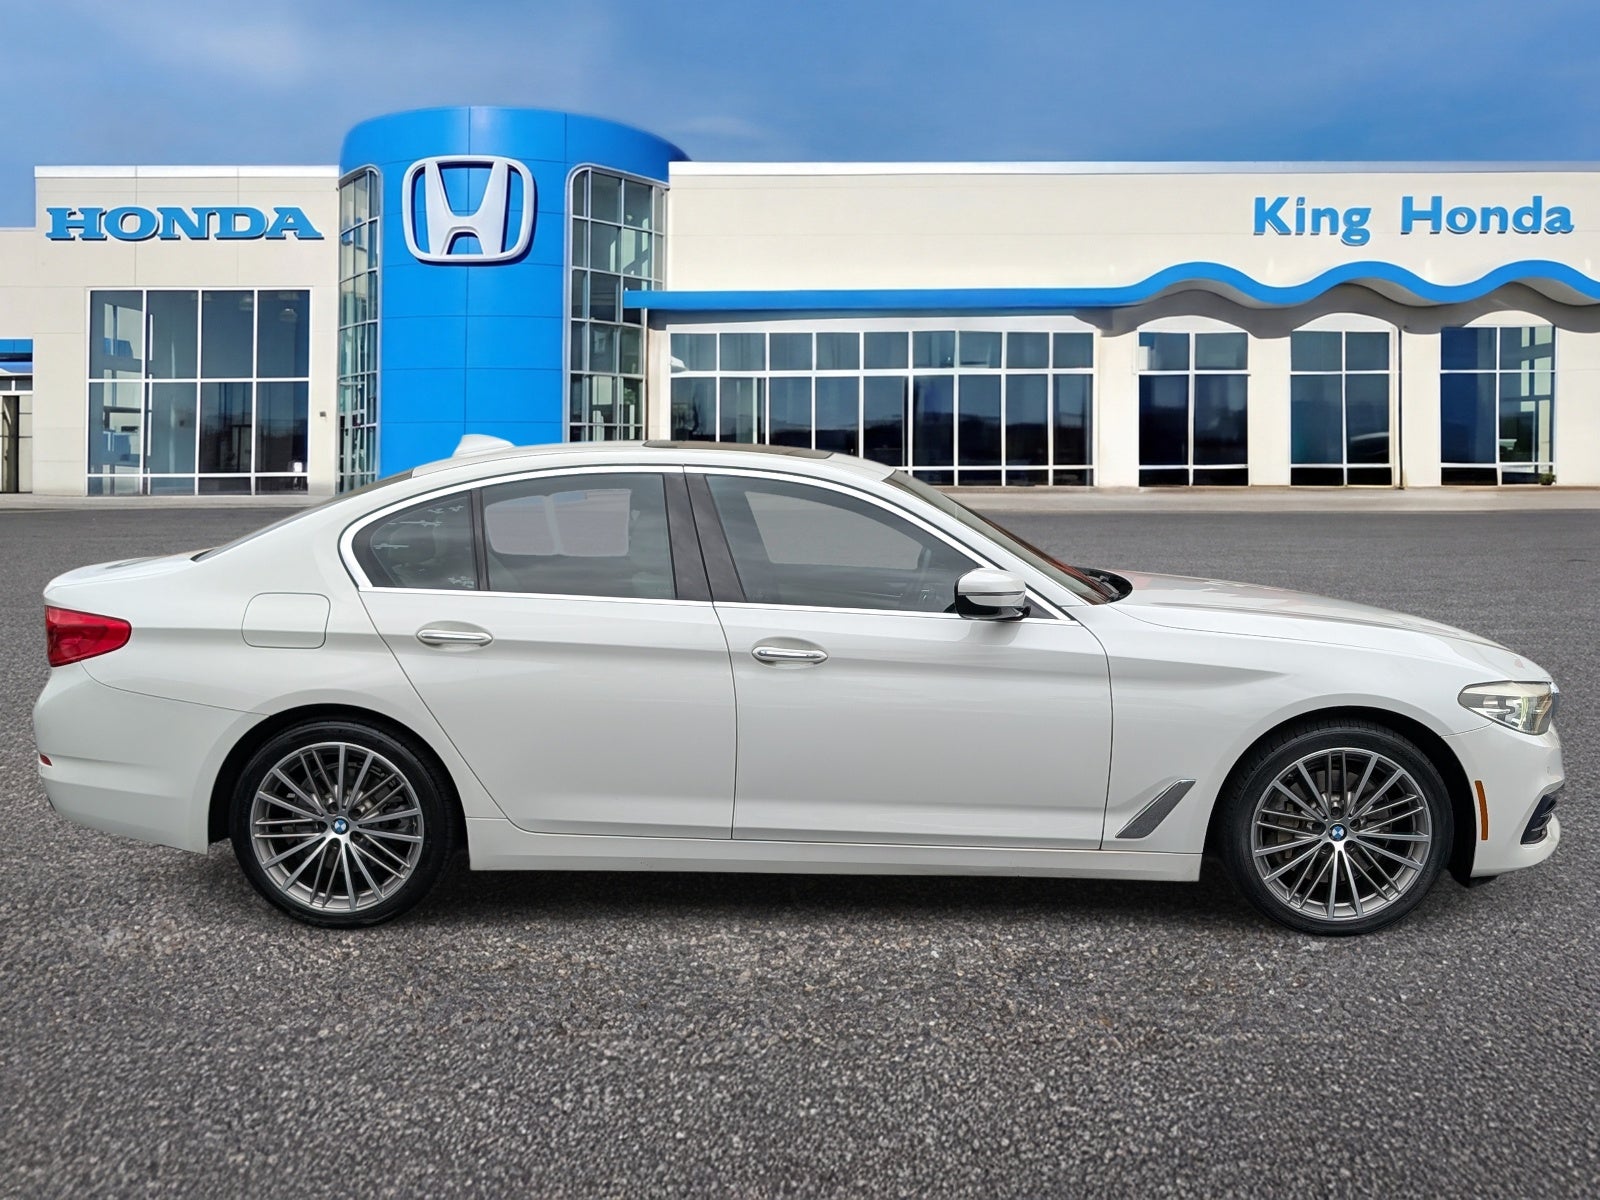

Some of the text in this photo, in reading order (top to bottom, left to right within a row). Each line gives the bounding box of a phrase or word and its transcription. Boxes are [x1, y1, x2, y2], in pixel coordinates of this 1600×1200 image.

[45, 206, 324, 241] HONDA
[1253, 195, 1574, 246] King Honda
